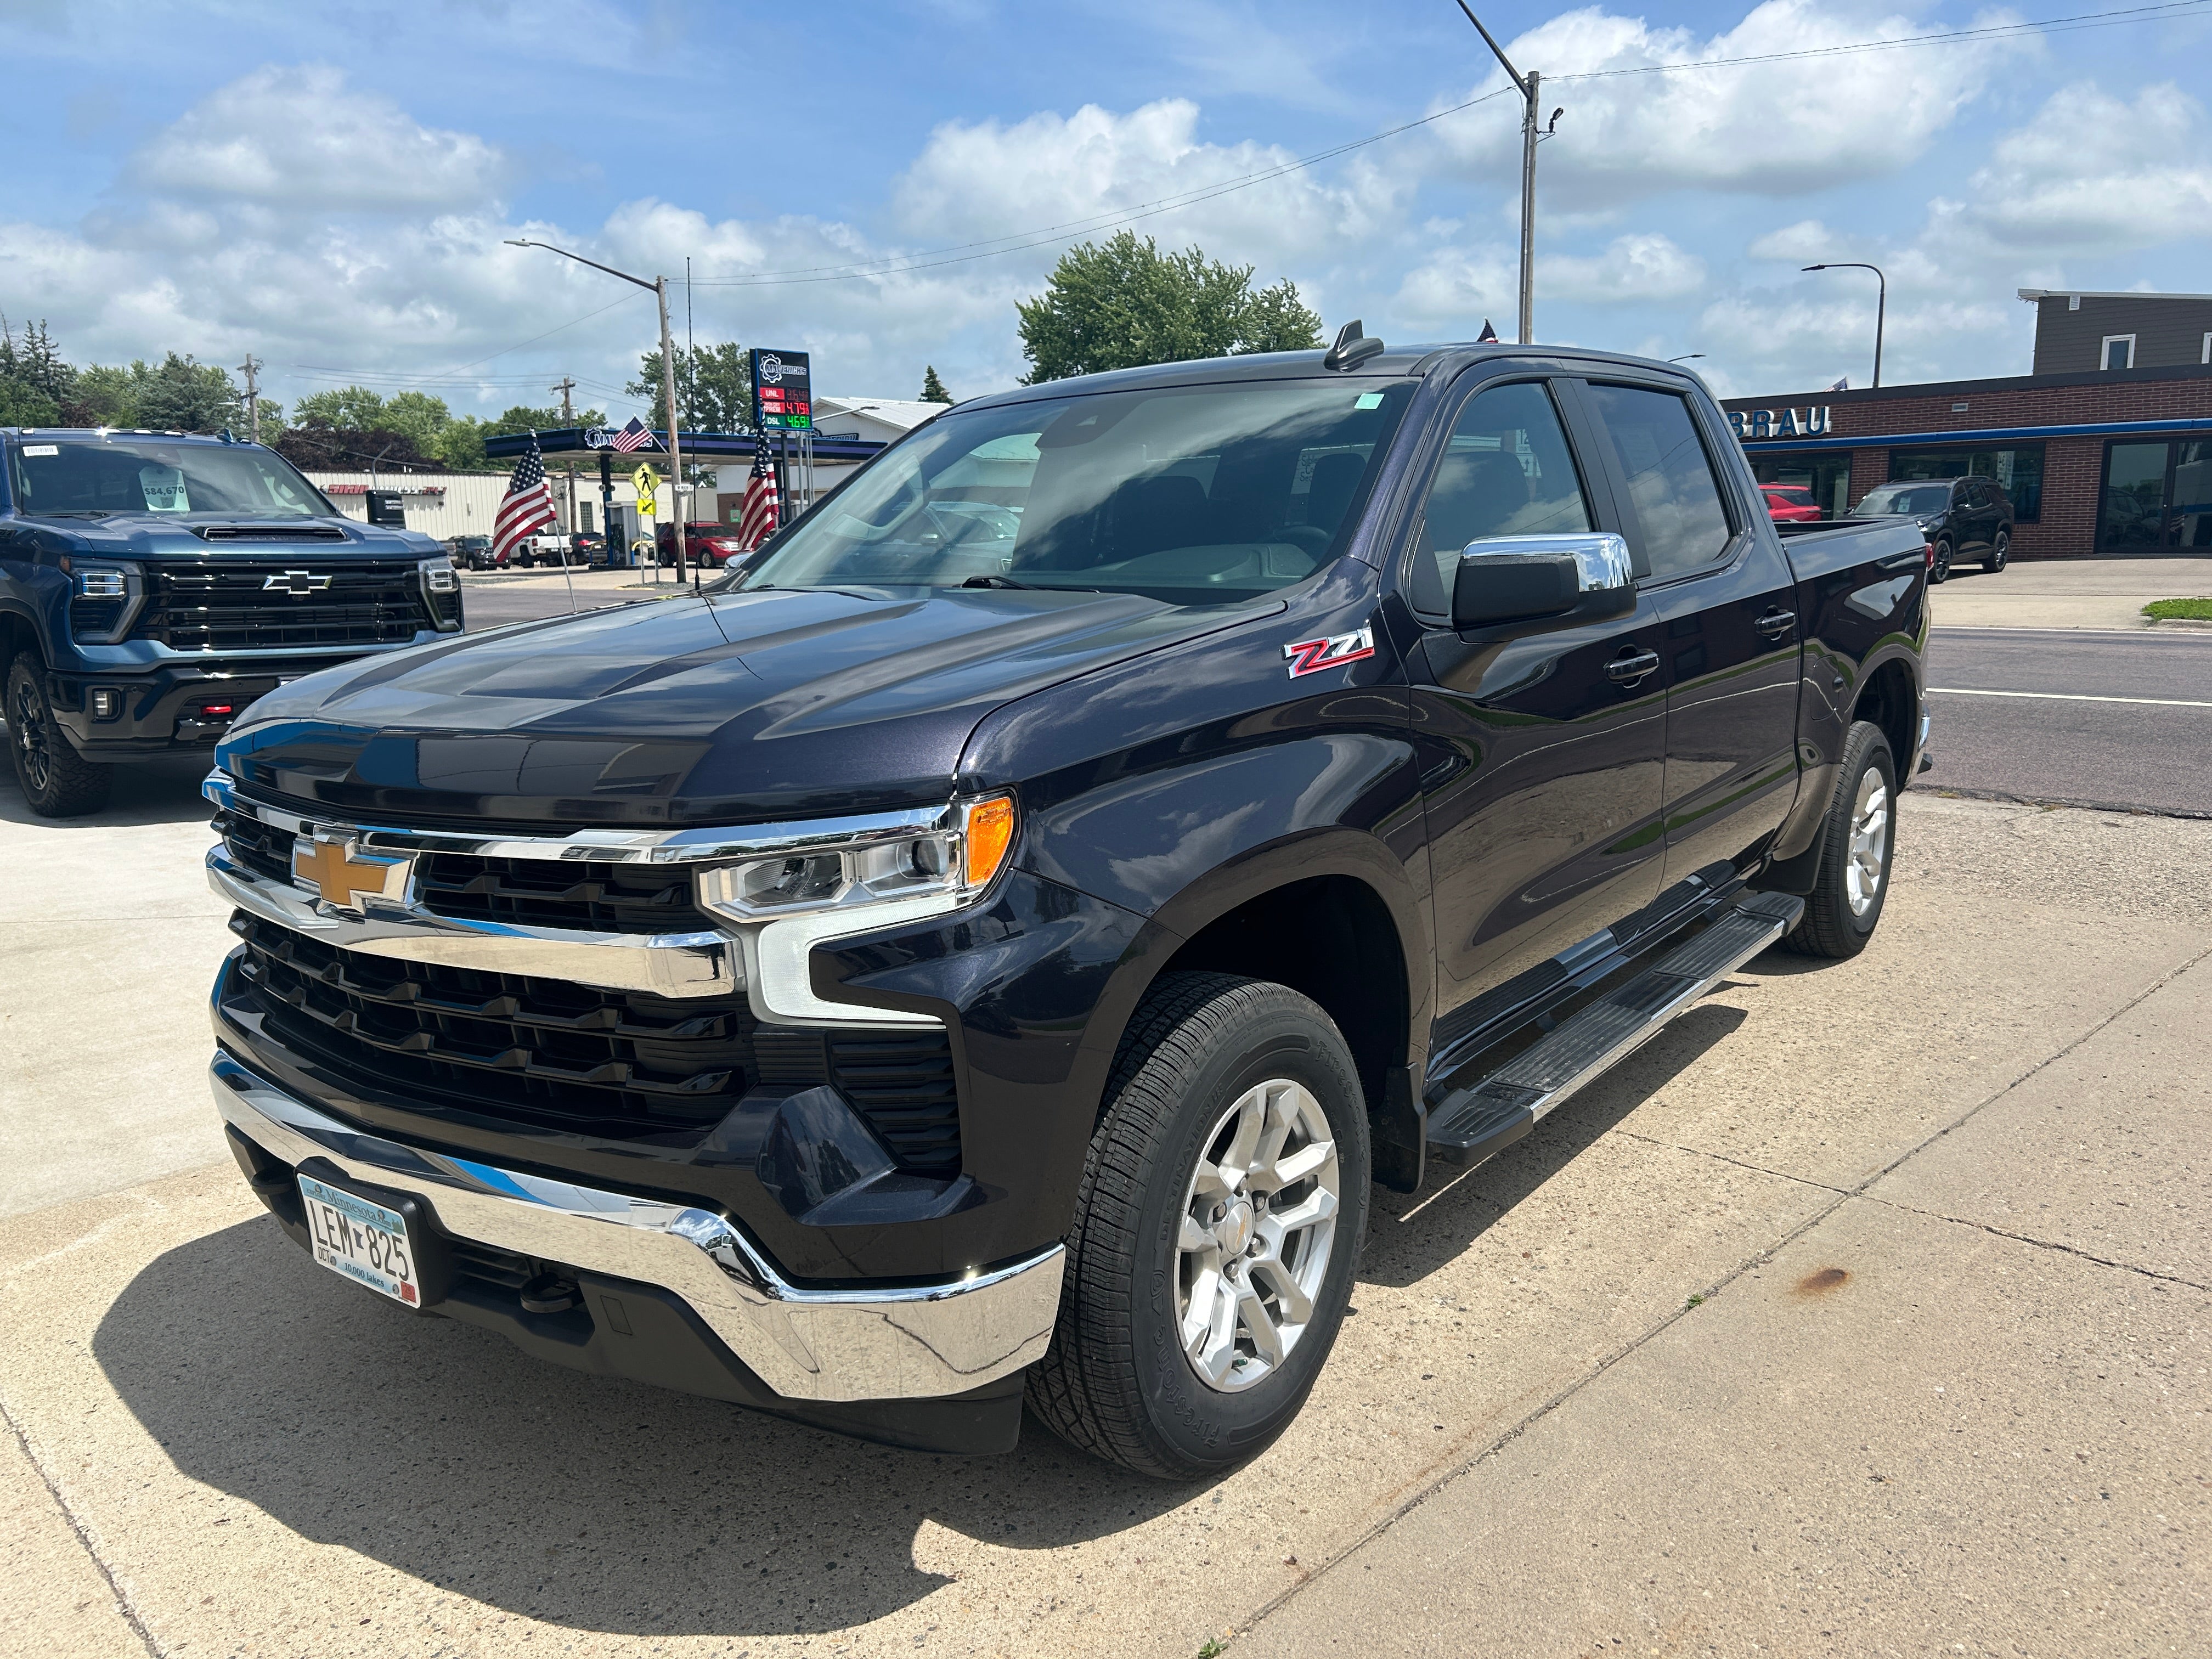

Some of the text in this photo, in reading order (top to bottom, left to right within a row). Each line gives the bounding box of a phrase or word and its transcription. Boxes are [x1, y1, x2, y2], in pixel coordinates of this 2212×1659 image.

[1727, 406, 1829, 438] BRAU
[144, 486, 185, 496] $84,670
[1283, 627, 1375, 680] Z71
[309, 1200, 409, 1282] LEM 825
[317, 1246, 331, 1263] OCT
[344, 1262, 385, 1288] 10,000 lakes
[1153, 1325, 1221, 1449] Firestone
